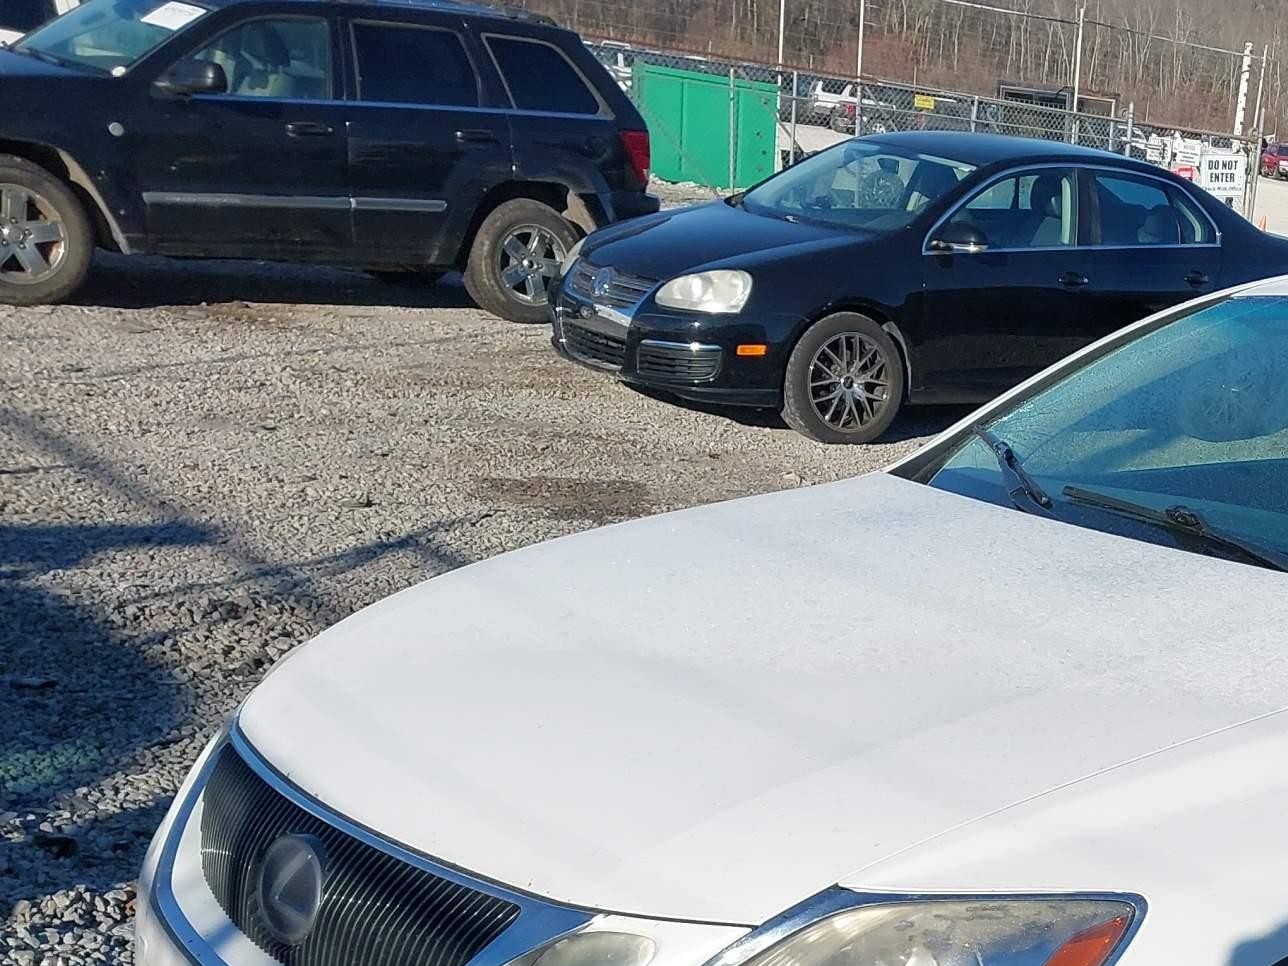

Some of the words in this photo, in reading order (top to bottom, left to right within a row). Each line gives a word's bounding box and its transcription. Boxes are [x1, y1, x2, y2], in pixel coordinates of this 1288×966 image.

[1208, 160, 1220, 170] DO
[1222, 160, 1239, 170] NOT
[1210, 172, 1235, 183] ENTER
